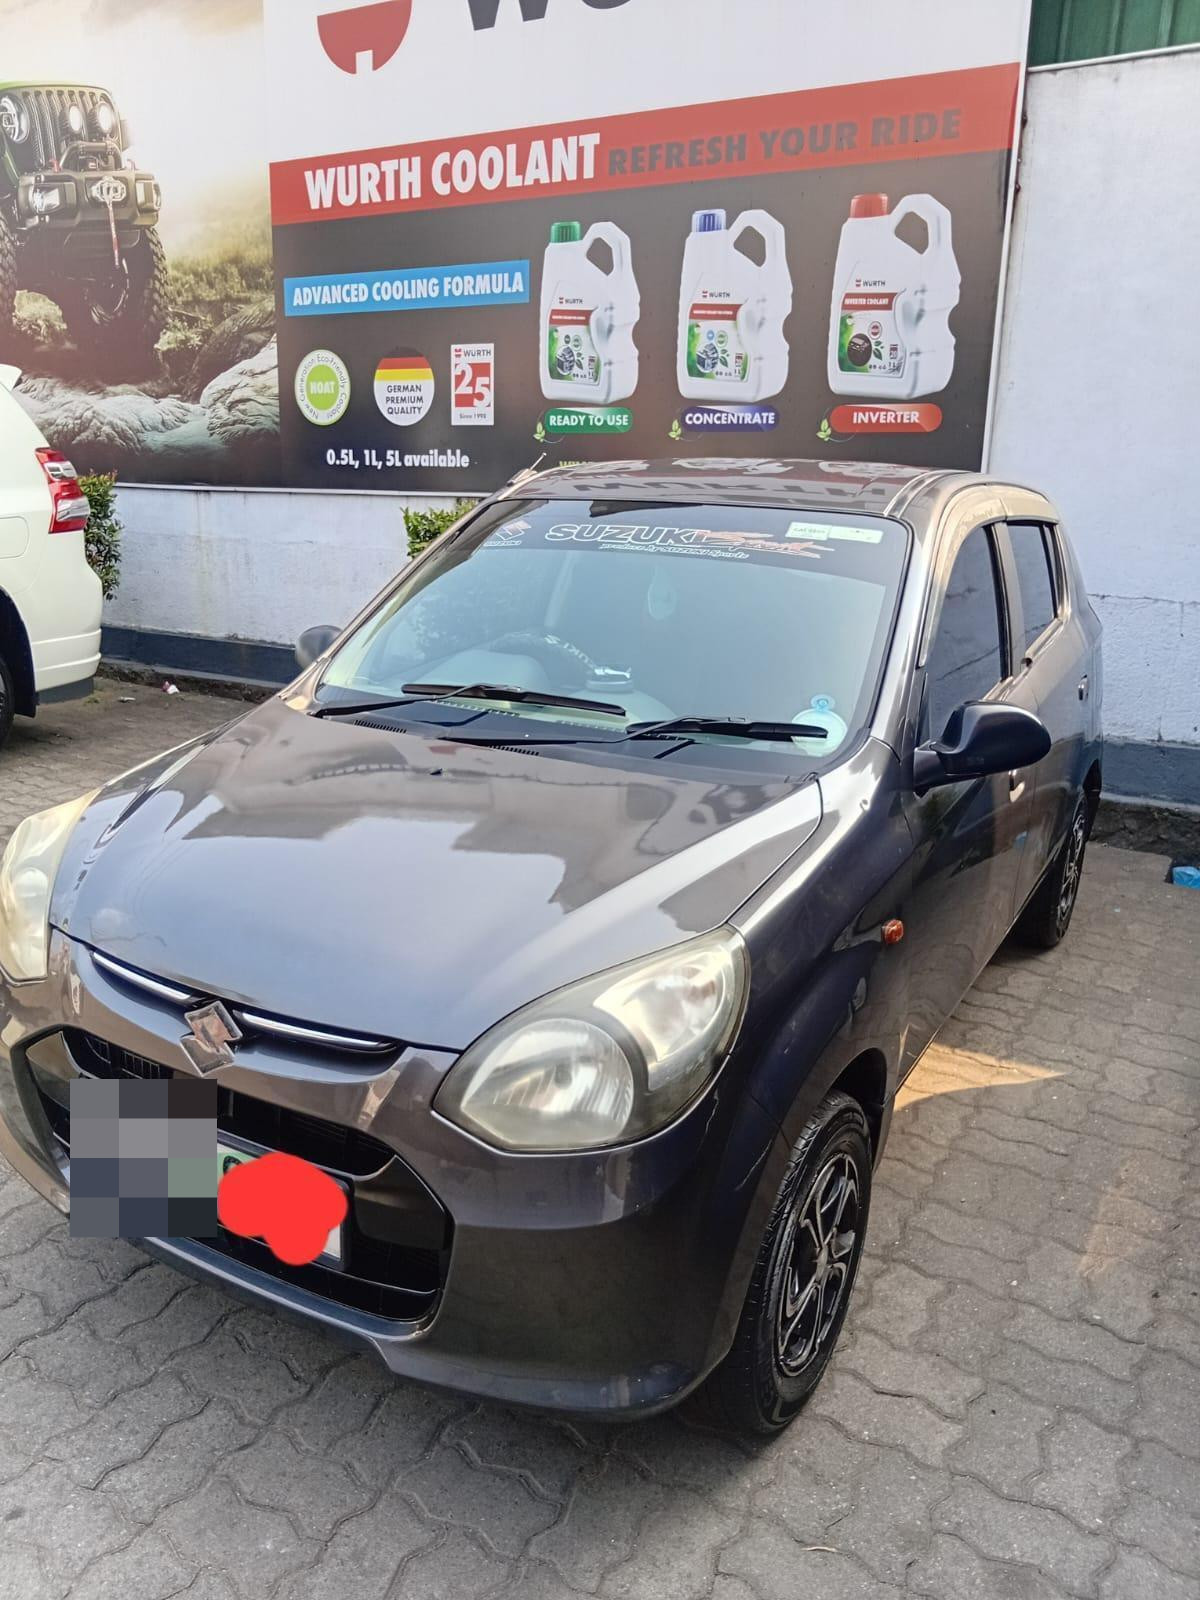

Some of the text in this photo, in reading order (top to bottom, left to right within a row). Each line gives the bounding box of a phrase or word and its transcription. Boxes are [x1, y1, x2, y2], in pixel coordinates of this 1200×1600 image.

[608, 108, 962, 177] REFRESH YOUR RIDE
[304, 133, 600, 210] WURTH COOLANT
[293, 271, 524, 306] ADVANCED COOLING FORMULA
[463, 349, 492, 357] WURTH
[386, 384, 422, 393] GERMAN
[454, 361, 491, 408] 25
[385, 395, 424, 404] PREMIUM
[387, 406, 422, 415] QUALITY
[549, 414, 629, 426] READY TO USE
[685, 412, 776, 424] CONCENTRATE
[852, 411, 920, 424] INVERTER
[326, 448, 470, 470] 0.5L, 1L, 5L available
[544, 523, 711, 547] SUZUKI
